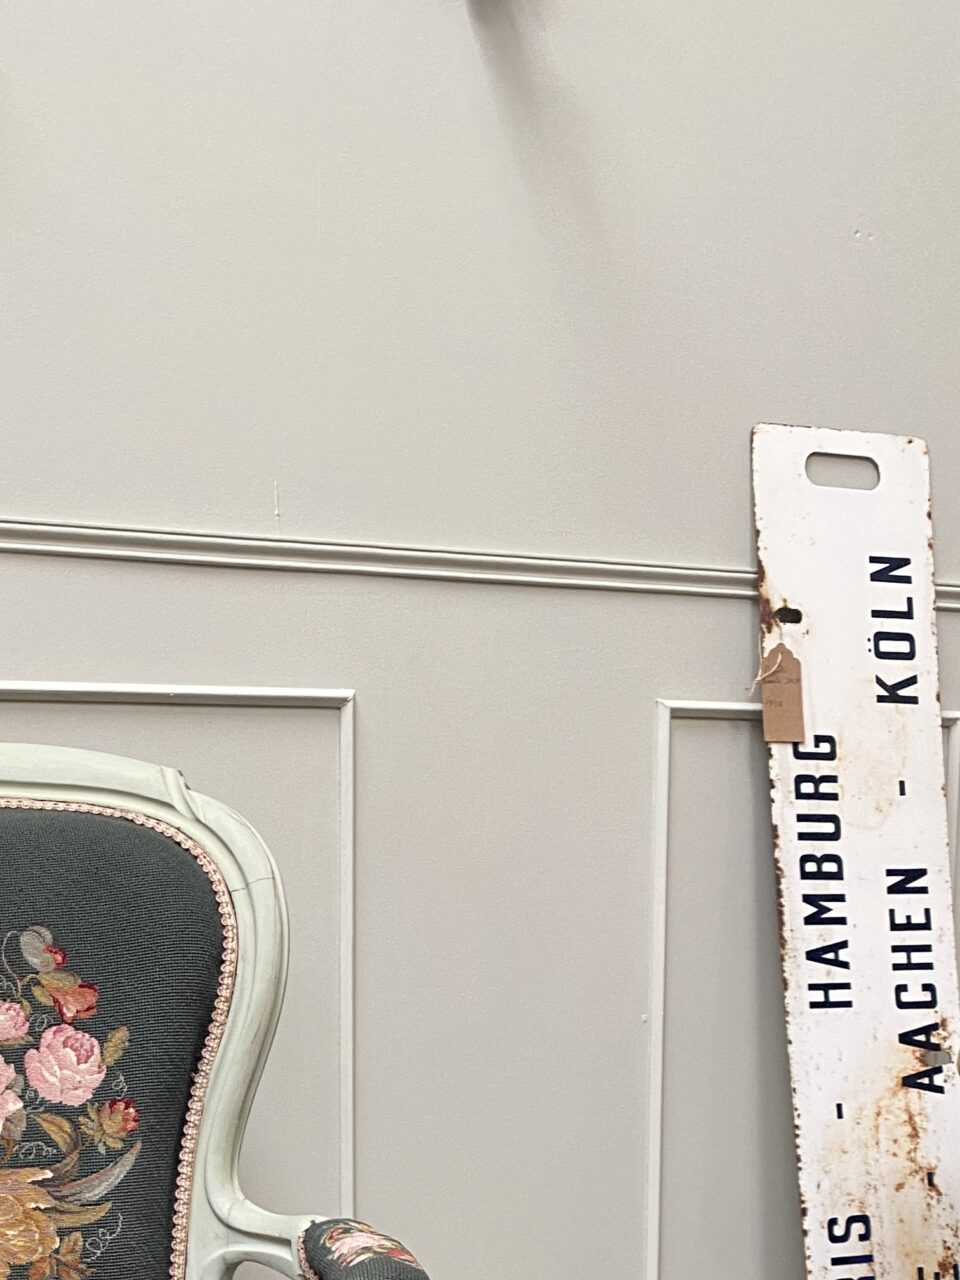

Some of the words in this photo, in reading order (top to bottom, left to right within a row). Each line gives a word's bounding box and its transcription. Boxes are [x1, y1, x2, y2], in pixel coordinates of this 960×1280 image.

[867, 555, 919, 705] KÖLN
[792, 734, 853, 1009] HAMBURG
[885, 868, 945, 1094] AACHEN
